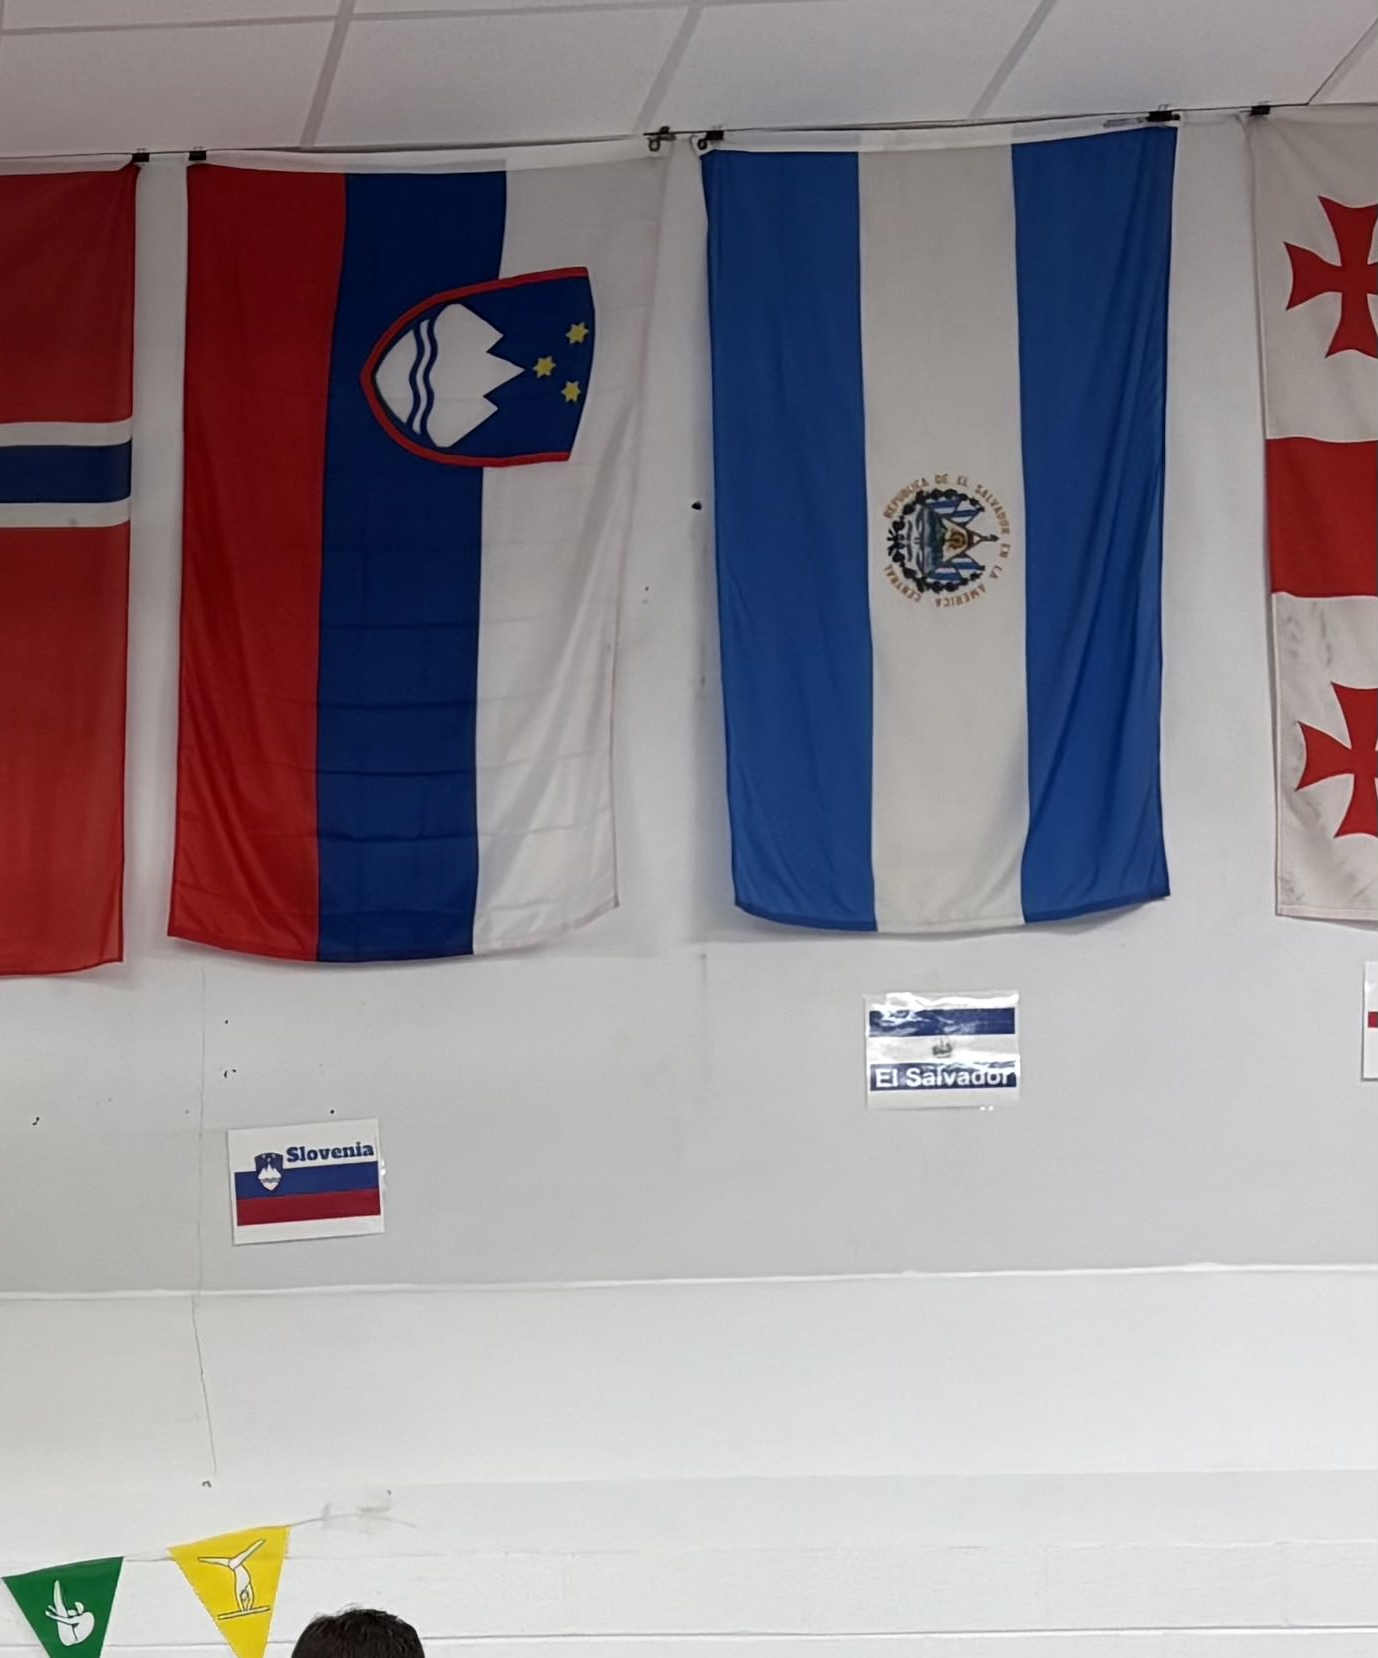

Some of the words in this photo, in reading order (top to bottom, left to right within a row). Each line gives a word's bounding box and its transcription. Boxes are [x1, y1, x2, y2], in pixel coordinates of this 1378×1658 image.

[875, 1068, 898, 1087] El
[906, 1067, 1009, 1087] Salvador
[286, 1141, 374, 1163] Slovenia
